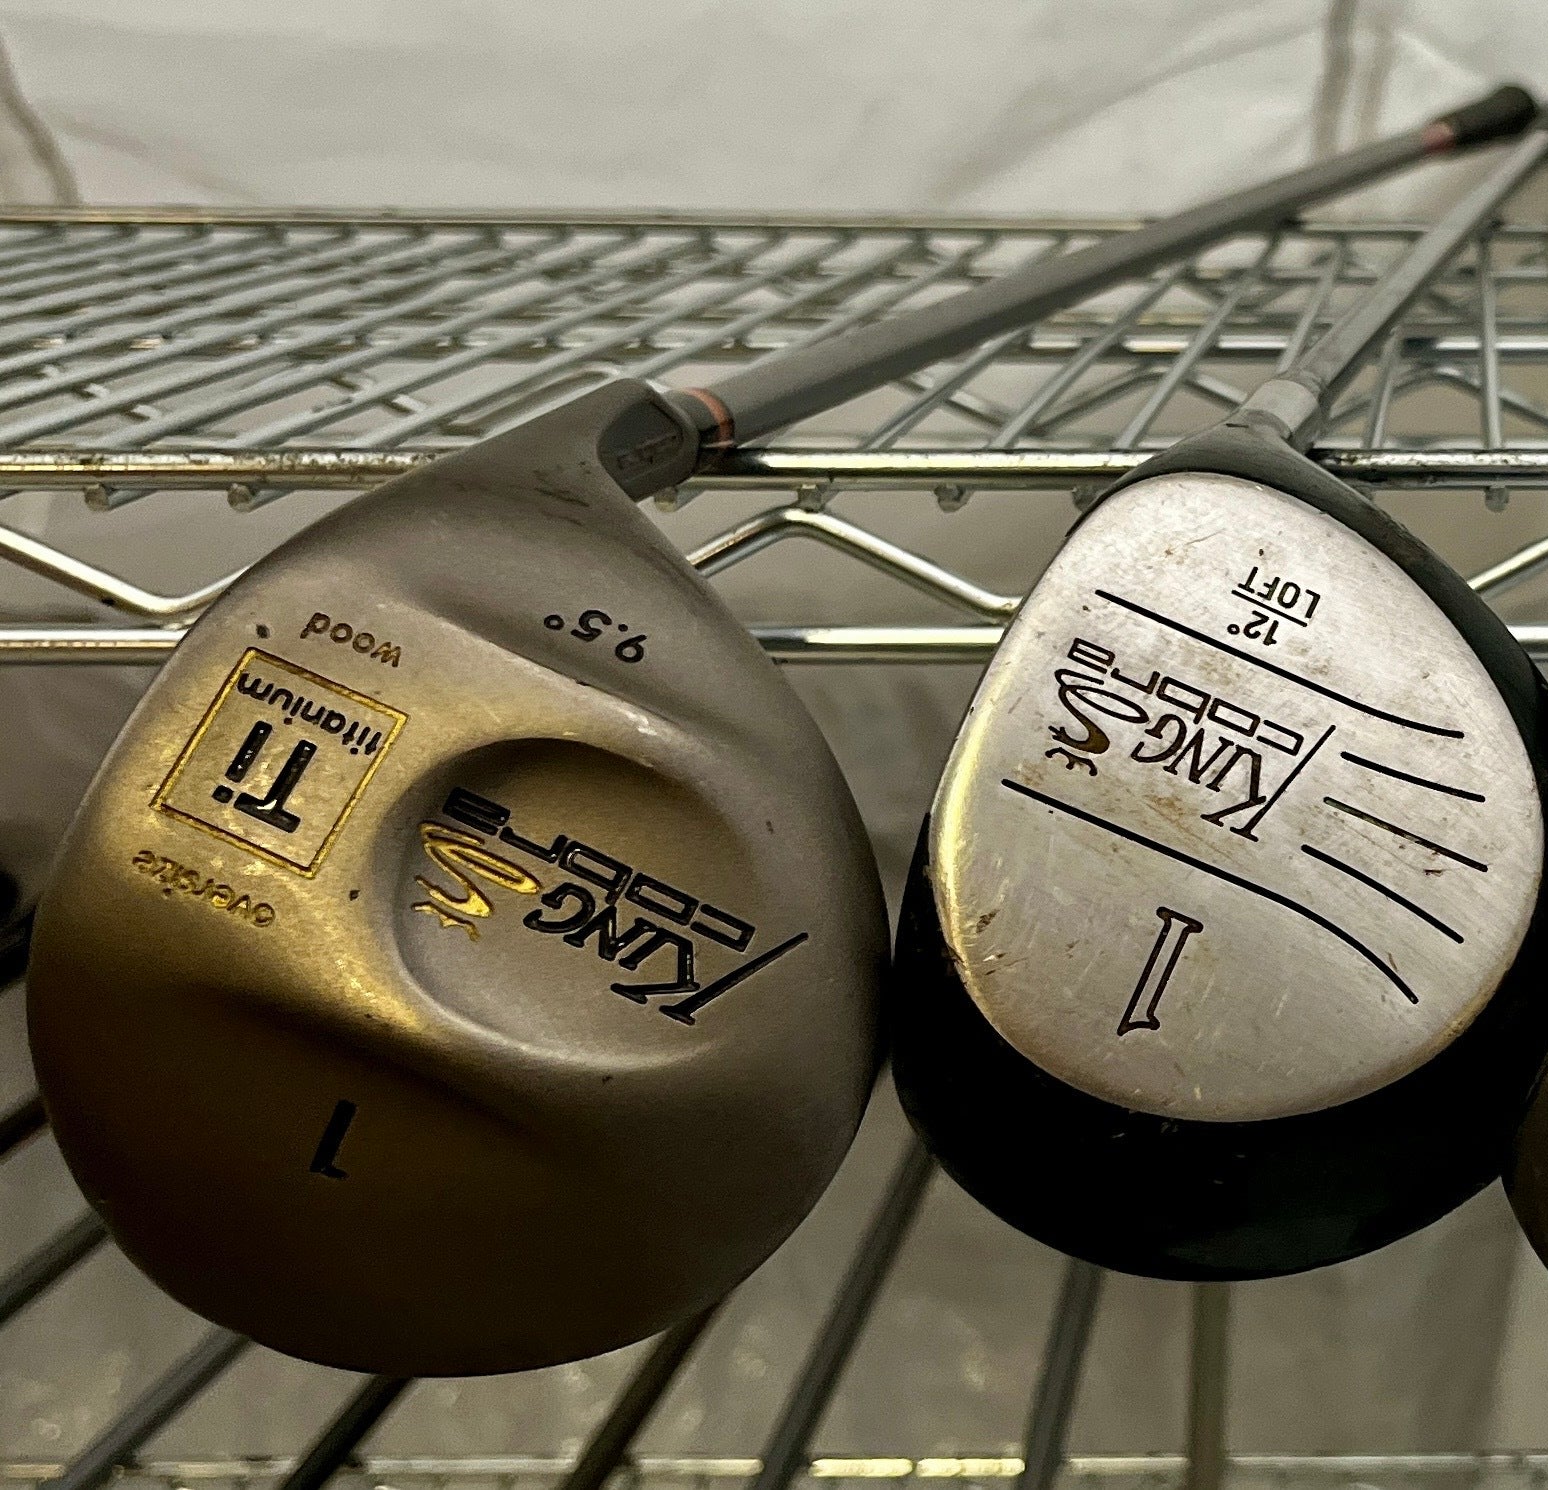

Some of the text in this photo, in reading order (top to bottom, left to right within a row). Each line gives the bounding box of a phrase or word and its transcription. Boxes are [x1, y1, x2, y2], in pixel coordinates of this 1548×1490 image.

[1226, 610, 1278, 646] 12°
[1232, 565, 1320, 620] LOFT
[301, 611, 402, 669] wood
[541, 609, 646, 663] 9.5°
[235, 672, 381, 758] titanium
[1064, 637, 1303, 757] cobra
[211, 719, 316, 834] Ti
[1129, 713, 1333, 843] KING
[128, 848, 275, 929] oversize
[441, 786, 754, 952] cobra
[520, 884, 808, 1025] KING
[1115, 905, 1203, 1036] 1
[309, 1099, 356, 1180] 1
